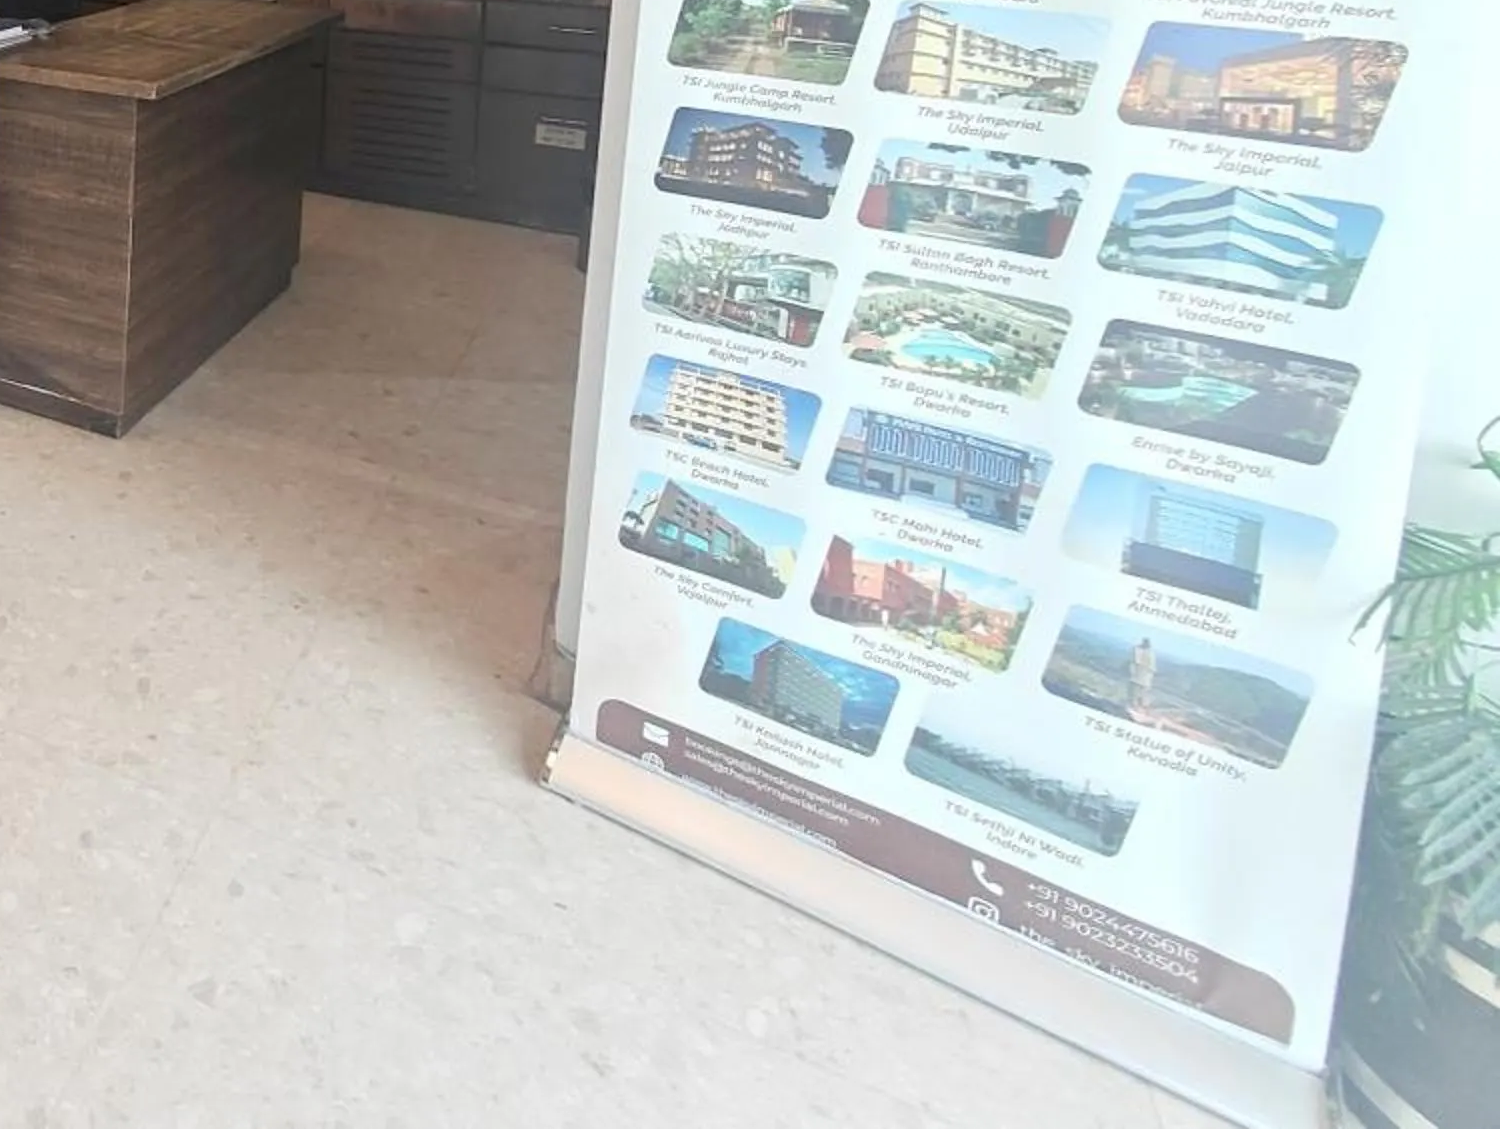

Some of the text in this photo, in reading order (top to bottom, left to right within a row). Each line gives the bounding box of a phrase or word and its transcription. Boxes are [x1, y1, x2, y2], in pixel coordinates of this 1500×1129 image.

[1201, 8, 1330, 29] Kumbhalgarh
[682, 75, 703, 86] TSI
[703, 79, 747, 94] Jungle
[749, 83, 789, 99] Camp
[917, 106, 944, 119] The
[947, 109, 974, 124] Sky
[947, 122, 1011, 141] Udaipur
[1167, 137, 1198, 153] The
[1202, 142, 1237, 159] Sky
[1213, 161, 1275, 177] Jaipur
[690, 204, 712, 216] The
[716, 208, 738, 222] Sky
[877, 239, 900, 251] TSI
[903, 244, 951, 259] Sultan
[954, 252, 994, 269] Bagh
[911, 258, 1012, 285] Ranthambore
[1156, 288, 1183, 303] TSI
[1175, 307, 1266, 333] Vadodara
[655, 323, 673, 334] TSI
[725, 339, 769, 359] Luxury
[879, 375, 902, 390] TSI
[1188, 448, 1211, 463] by
[1165, 458, 1236, 483] Dwarka
[897, 528, 953, 553] Dwarka
[654, 565, 675, 580] The
[1135, 586, 1162, 603] TSI
[1126, 600, 1238, 640] Ahmedabad
[851, 633, 876, 650] The
[878, 642, 904, 659] Sky
[1084, 715, 1111, 734] TSI
[1113, 727, 1171, 754] Statue
[1174, 746, 1195, 761] of
[986, 831, 1038, 859] Indore
[1019, 831, 1036, 847] Ni
[1027, 882, 1200, 964] +91 9024475616
[1026, 901, 1199, 984] +91 9023233504
